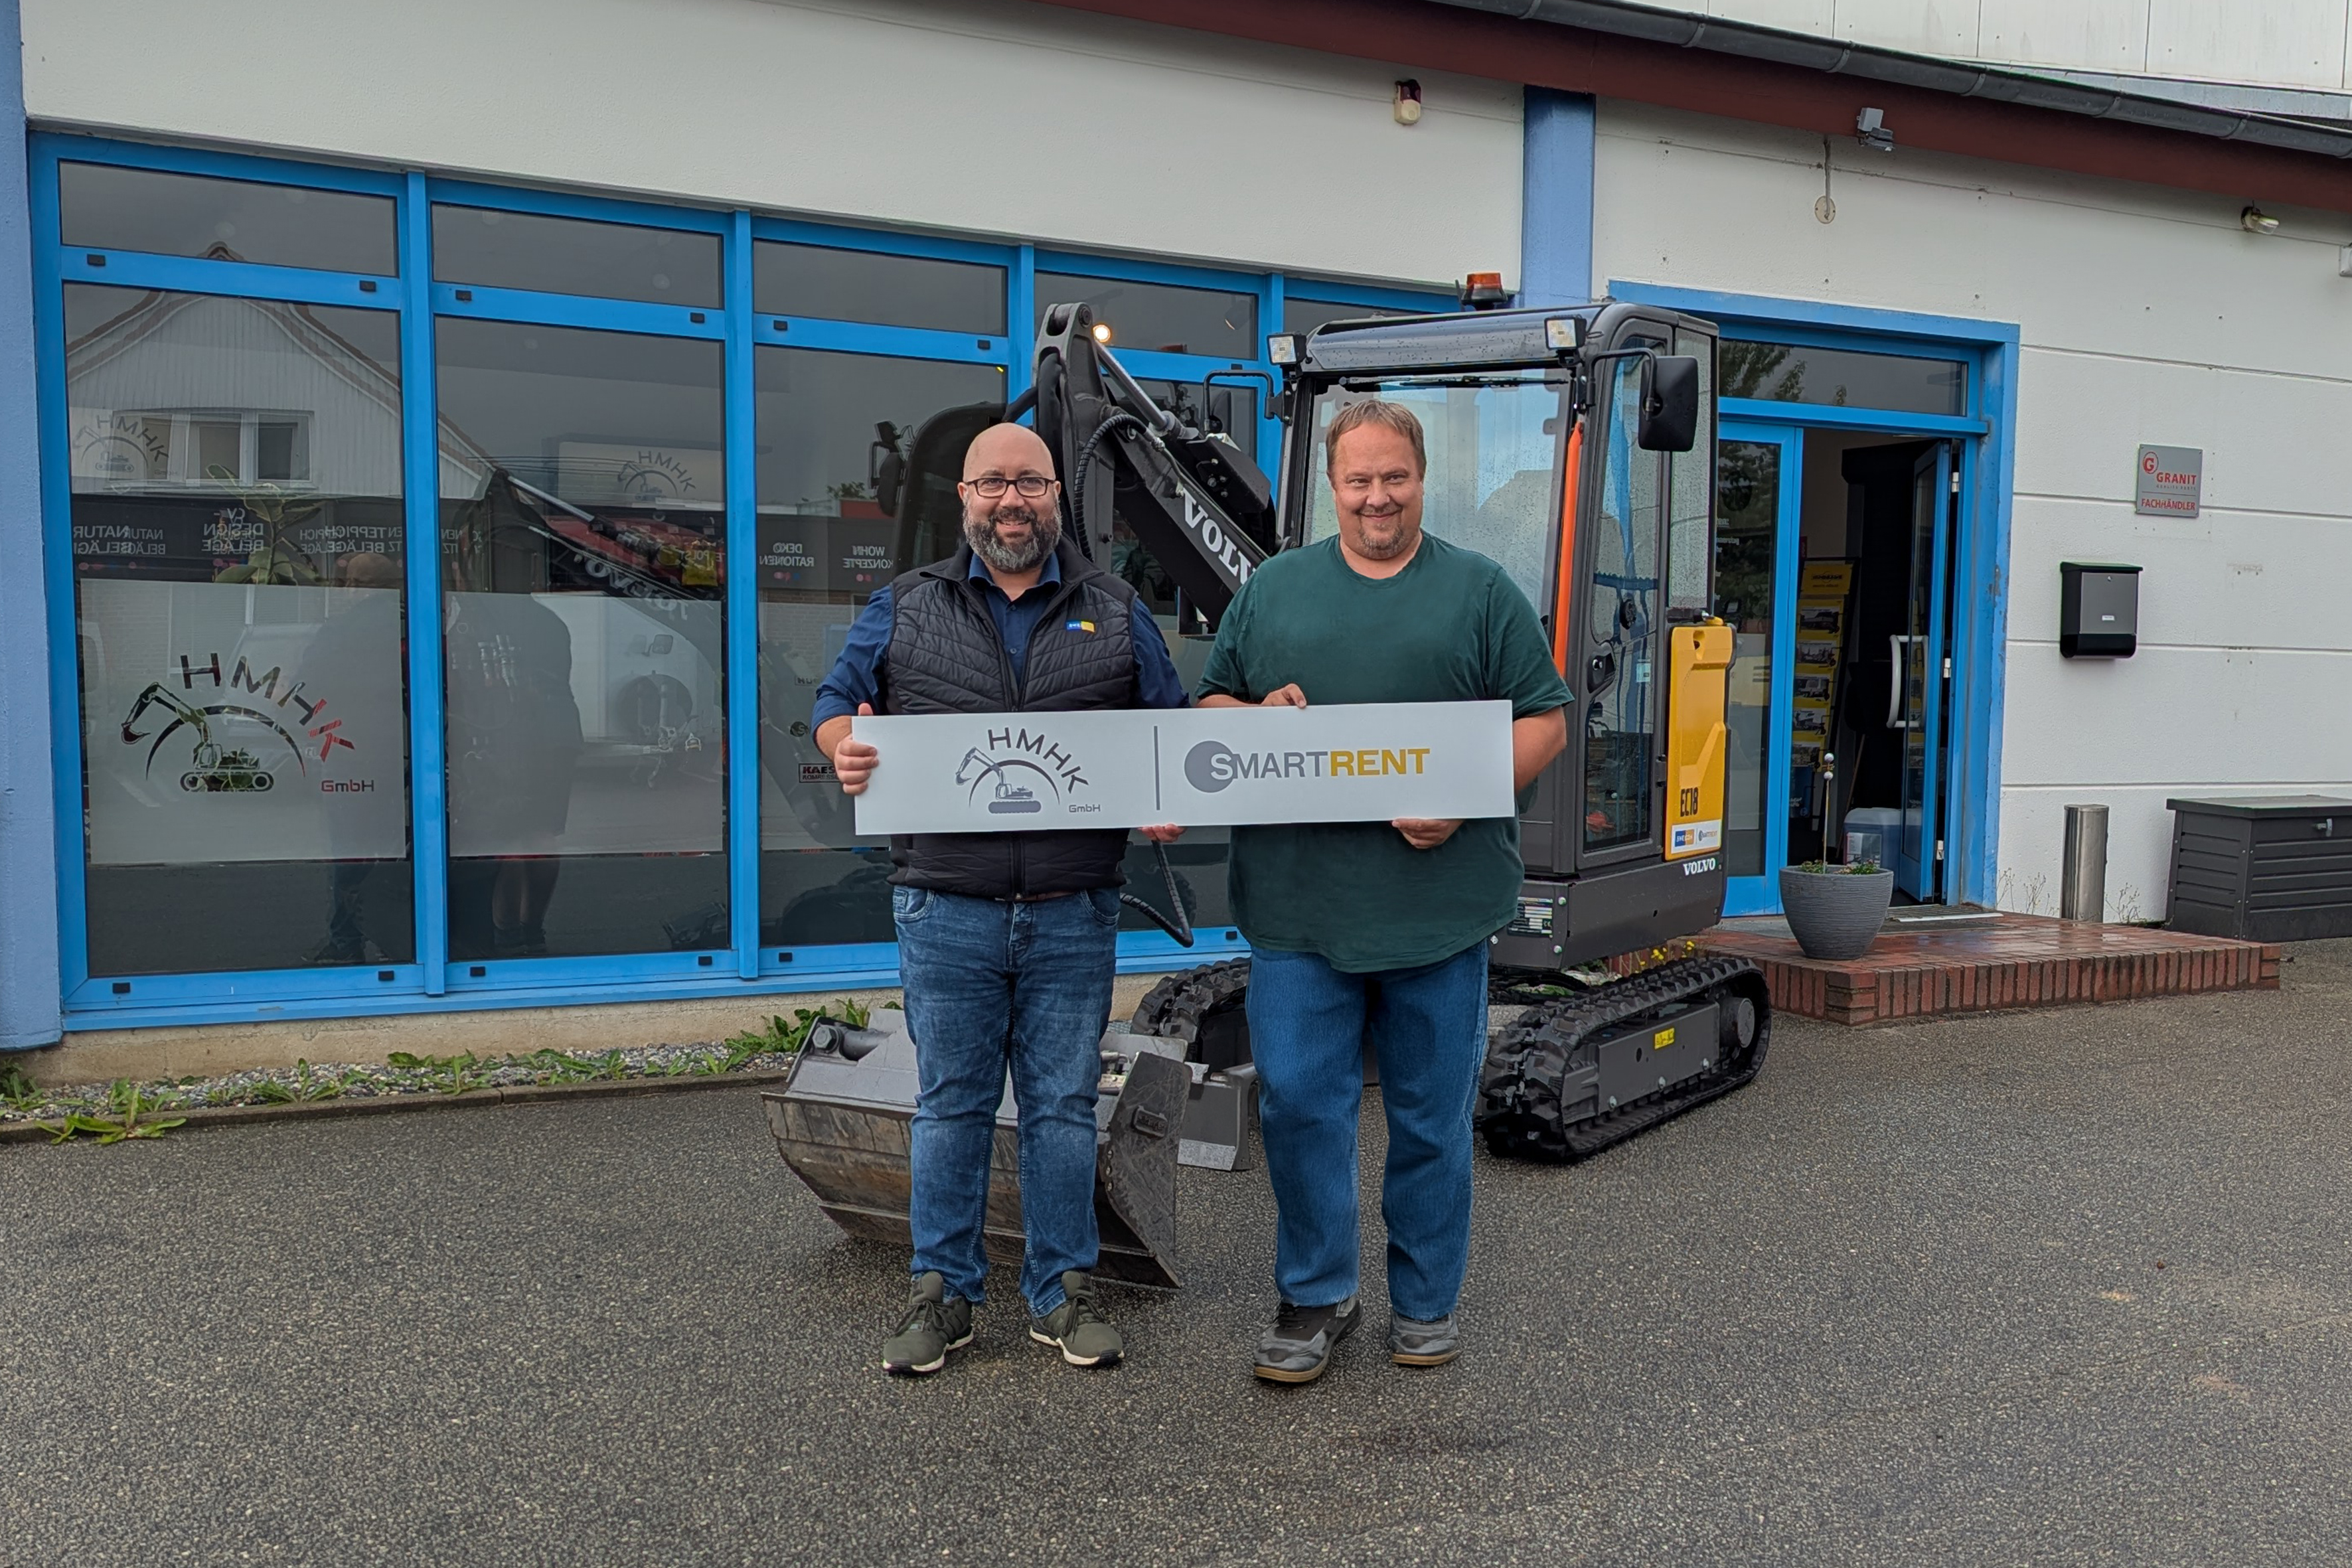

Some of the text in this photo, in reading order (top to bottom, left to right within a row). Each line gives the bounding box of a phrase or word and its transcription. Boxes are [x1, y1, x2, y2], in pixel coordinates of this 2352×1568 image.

[96, 414, 169, 463] HMHK
[638, 450, 696, 492] HMHK
[2156, 472, 2197, 485] GRANIT
[2141, 498, 2195, 511] FACHHÄNDLER
[1182, 487, 1257, 586] VOLV
[180, 653, 355, 763] HMHK
[987, 727, 1089, 794] HMHK
[1210, 747, 1431, 781] SMARTRENT
[321, 779, 375, 793] GmbH
[1680, 787, 1699, 817] EC18
[1068, 803, 1101, 813] GmbH
[1683, 857, 1716, 876] VOLVO
